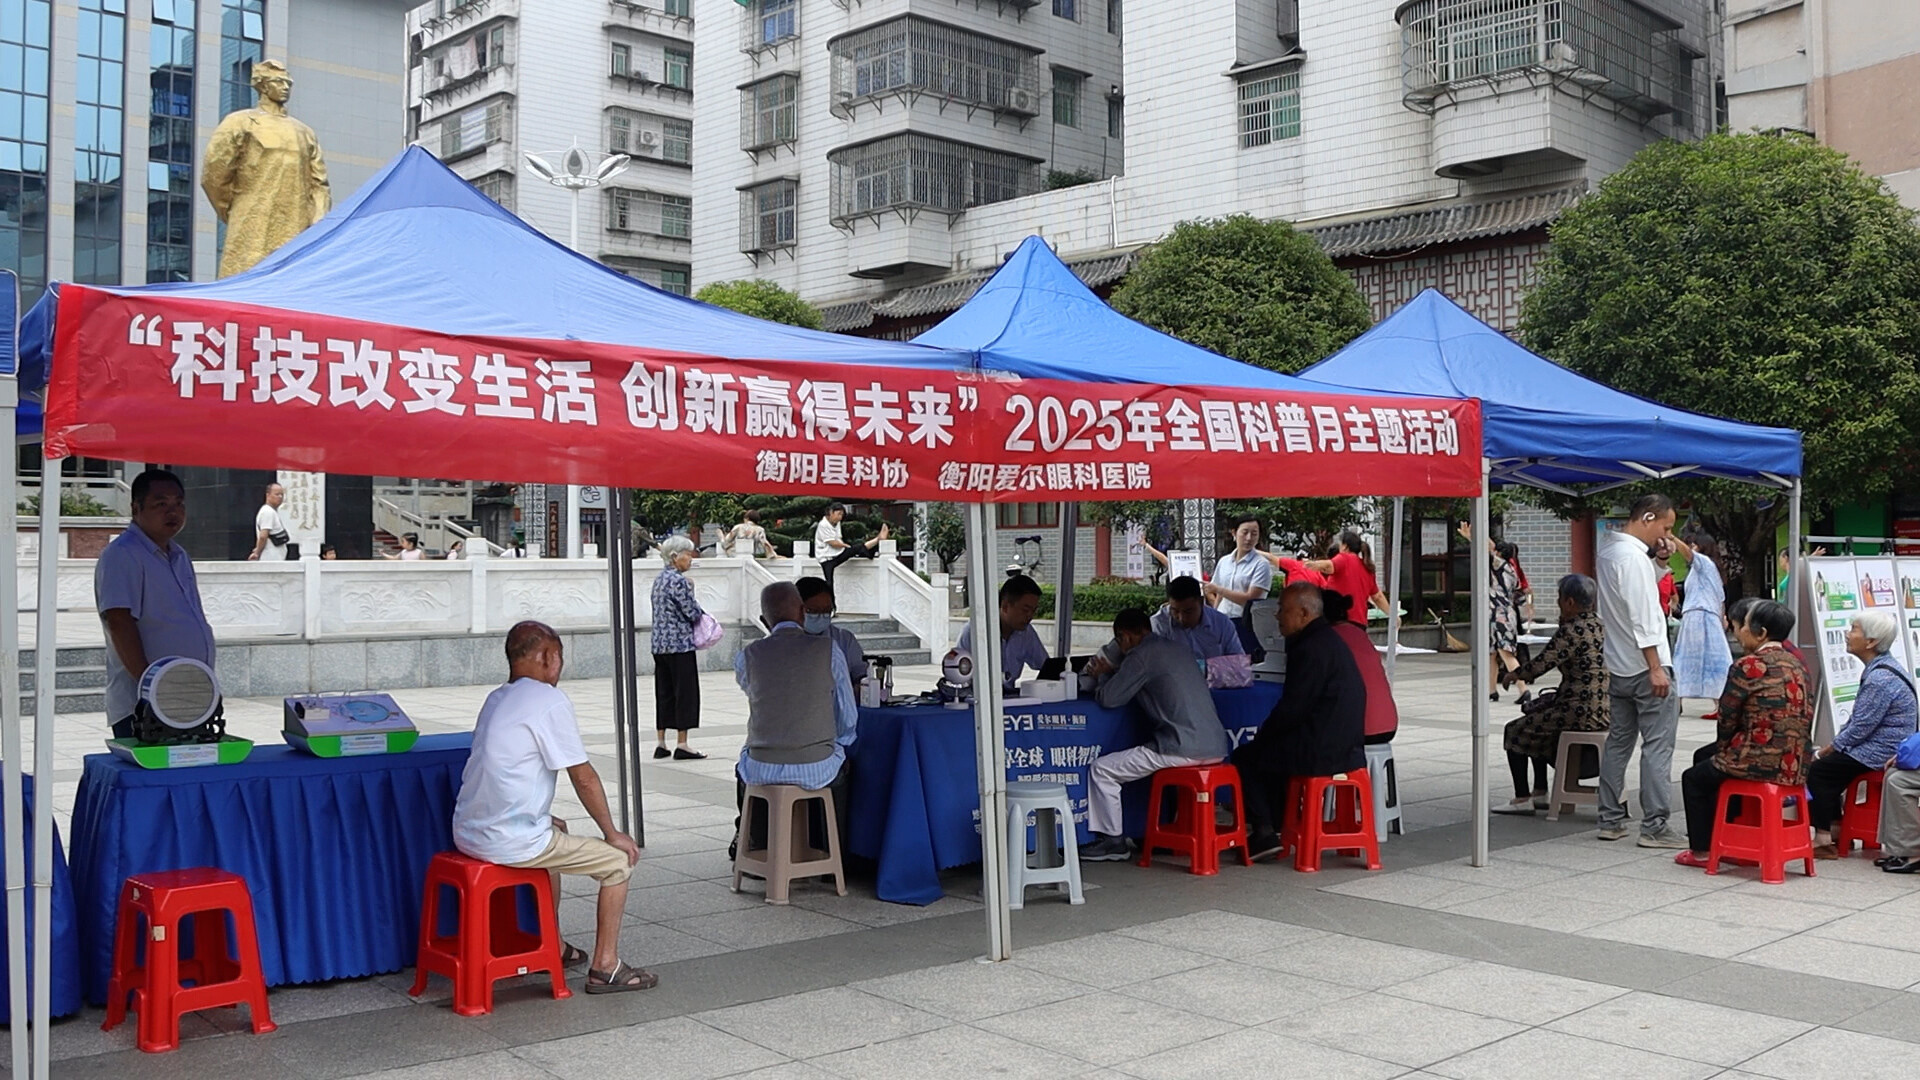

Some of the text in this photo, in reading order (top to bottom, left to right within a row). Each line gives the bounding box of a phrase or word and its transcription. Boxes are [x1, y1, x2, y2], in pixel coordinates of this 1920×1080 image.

[128, 313, 1460, 457] “科技改变生活 创新赢得未来” 2025年全国科普月主题活动
[755, 449, 1153, 492] 衡阳县科协 衡阳爱尔眼科医院
